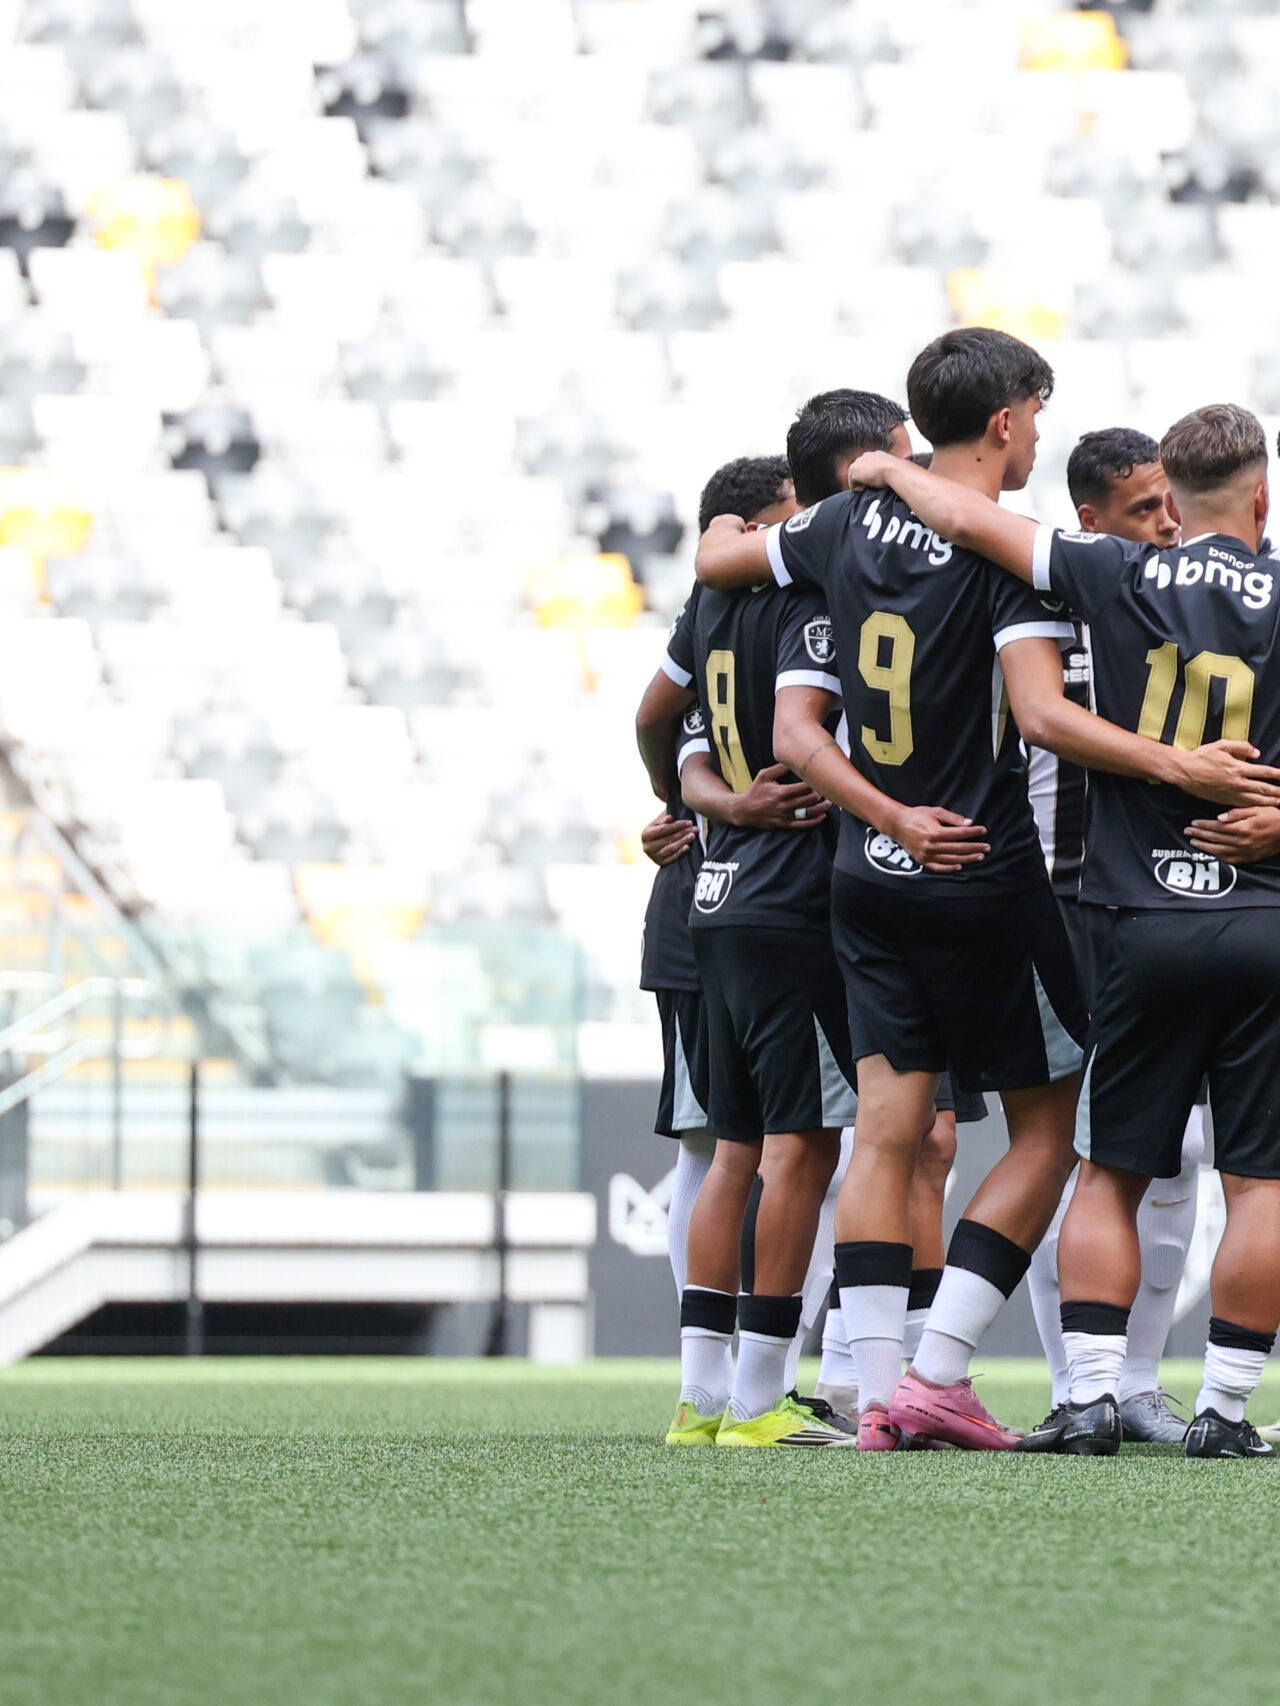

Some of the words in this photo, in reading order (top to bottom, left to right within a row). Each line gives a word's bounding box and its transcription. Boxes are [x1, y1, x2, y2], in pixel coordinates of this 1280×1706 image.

[1208, 546, 1255, 569] banco
[1175, 556, 1274, 610] bmg
[857, 611, 916, 766] 9
[1137, 641, 1255, 785] 10
[696, 871, 728, 902] BH
[1166, 861, 1220, 891] BH
